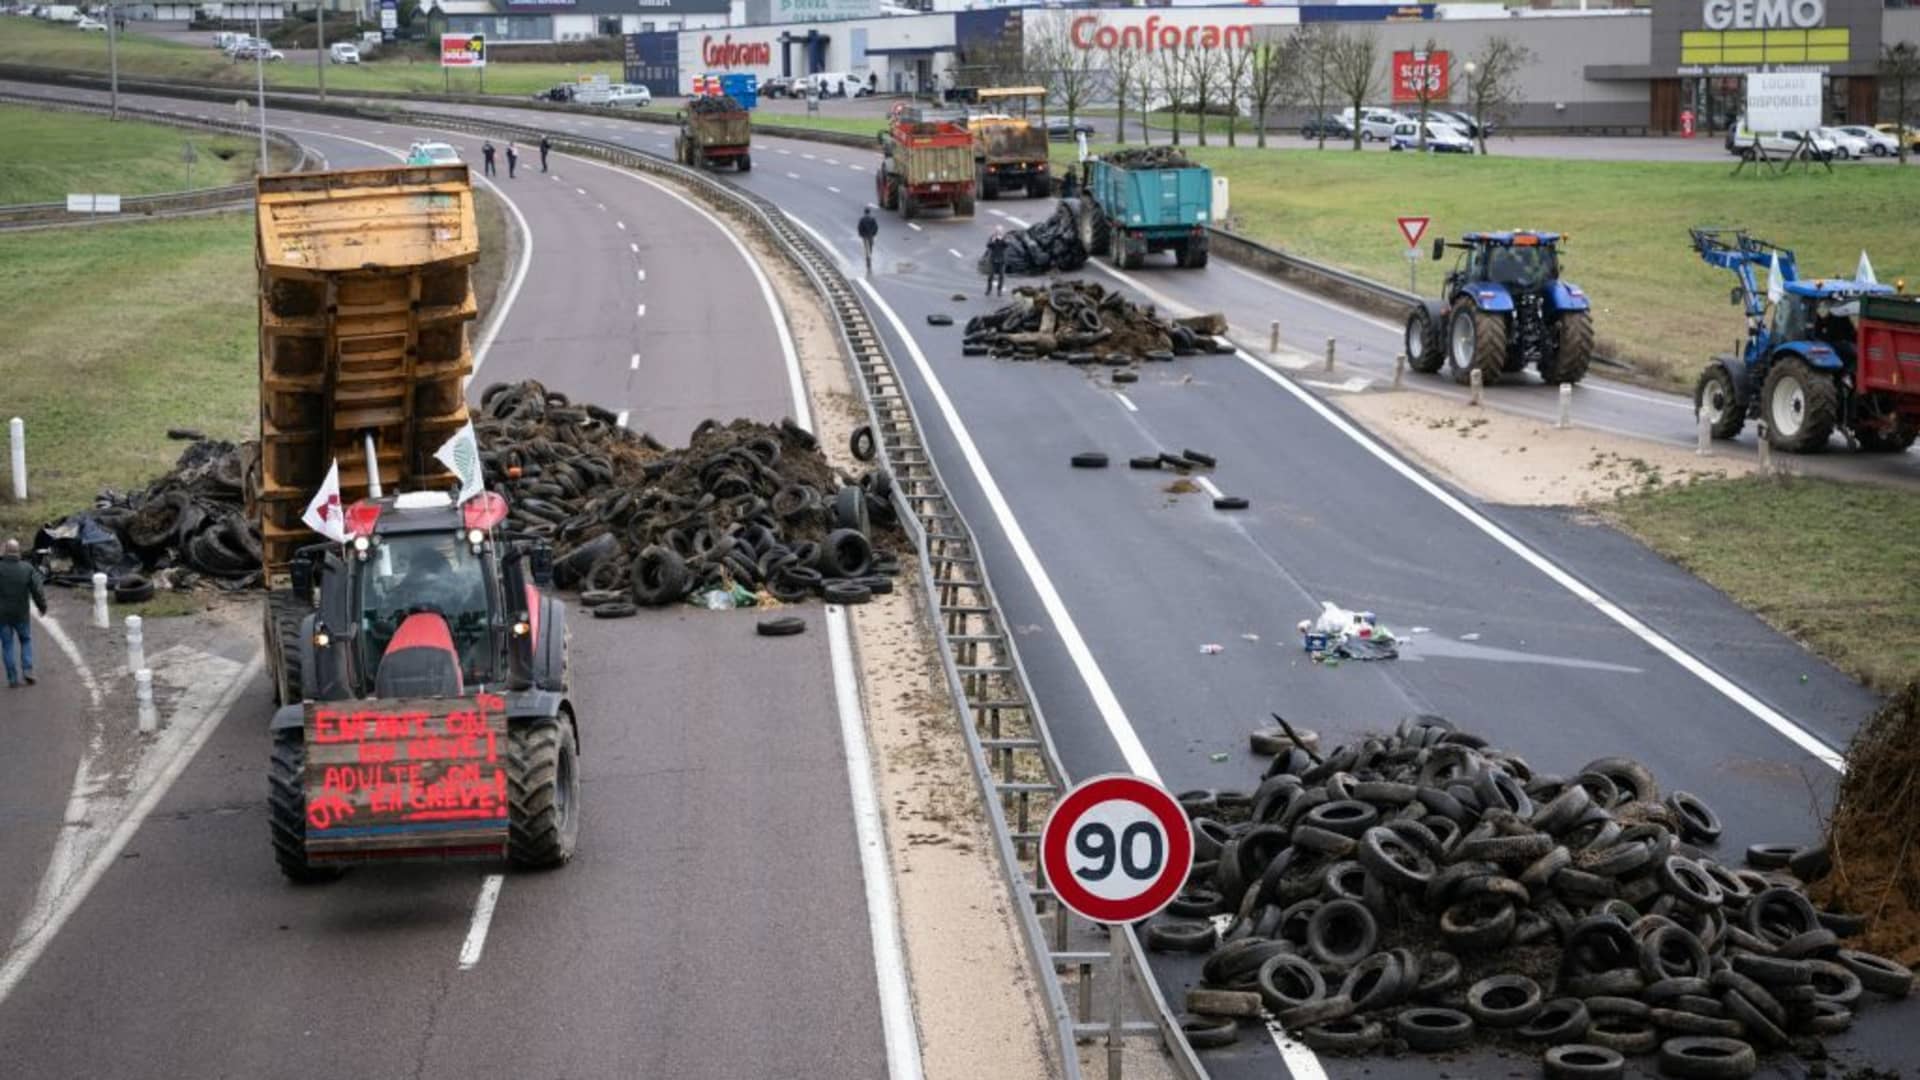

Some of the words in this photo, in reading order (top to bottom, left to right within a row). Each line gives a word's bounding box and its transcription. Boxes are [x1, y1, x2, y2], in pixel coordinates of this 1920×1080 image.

[703, 33, 771, 69] Conforama
[316, 710, 432, 743] ENFANT
[445, 710, 487, 736] ON
[324, 764, 424, 793] ADULTE
[447, 763, 480, 783] ON
[1075, 820, 1163, 882] 90
